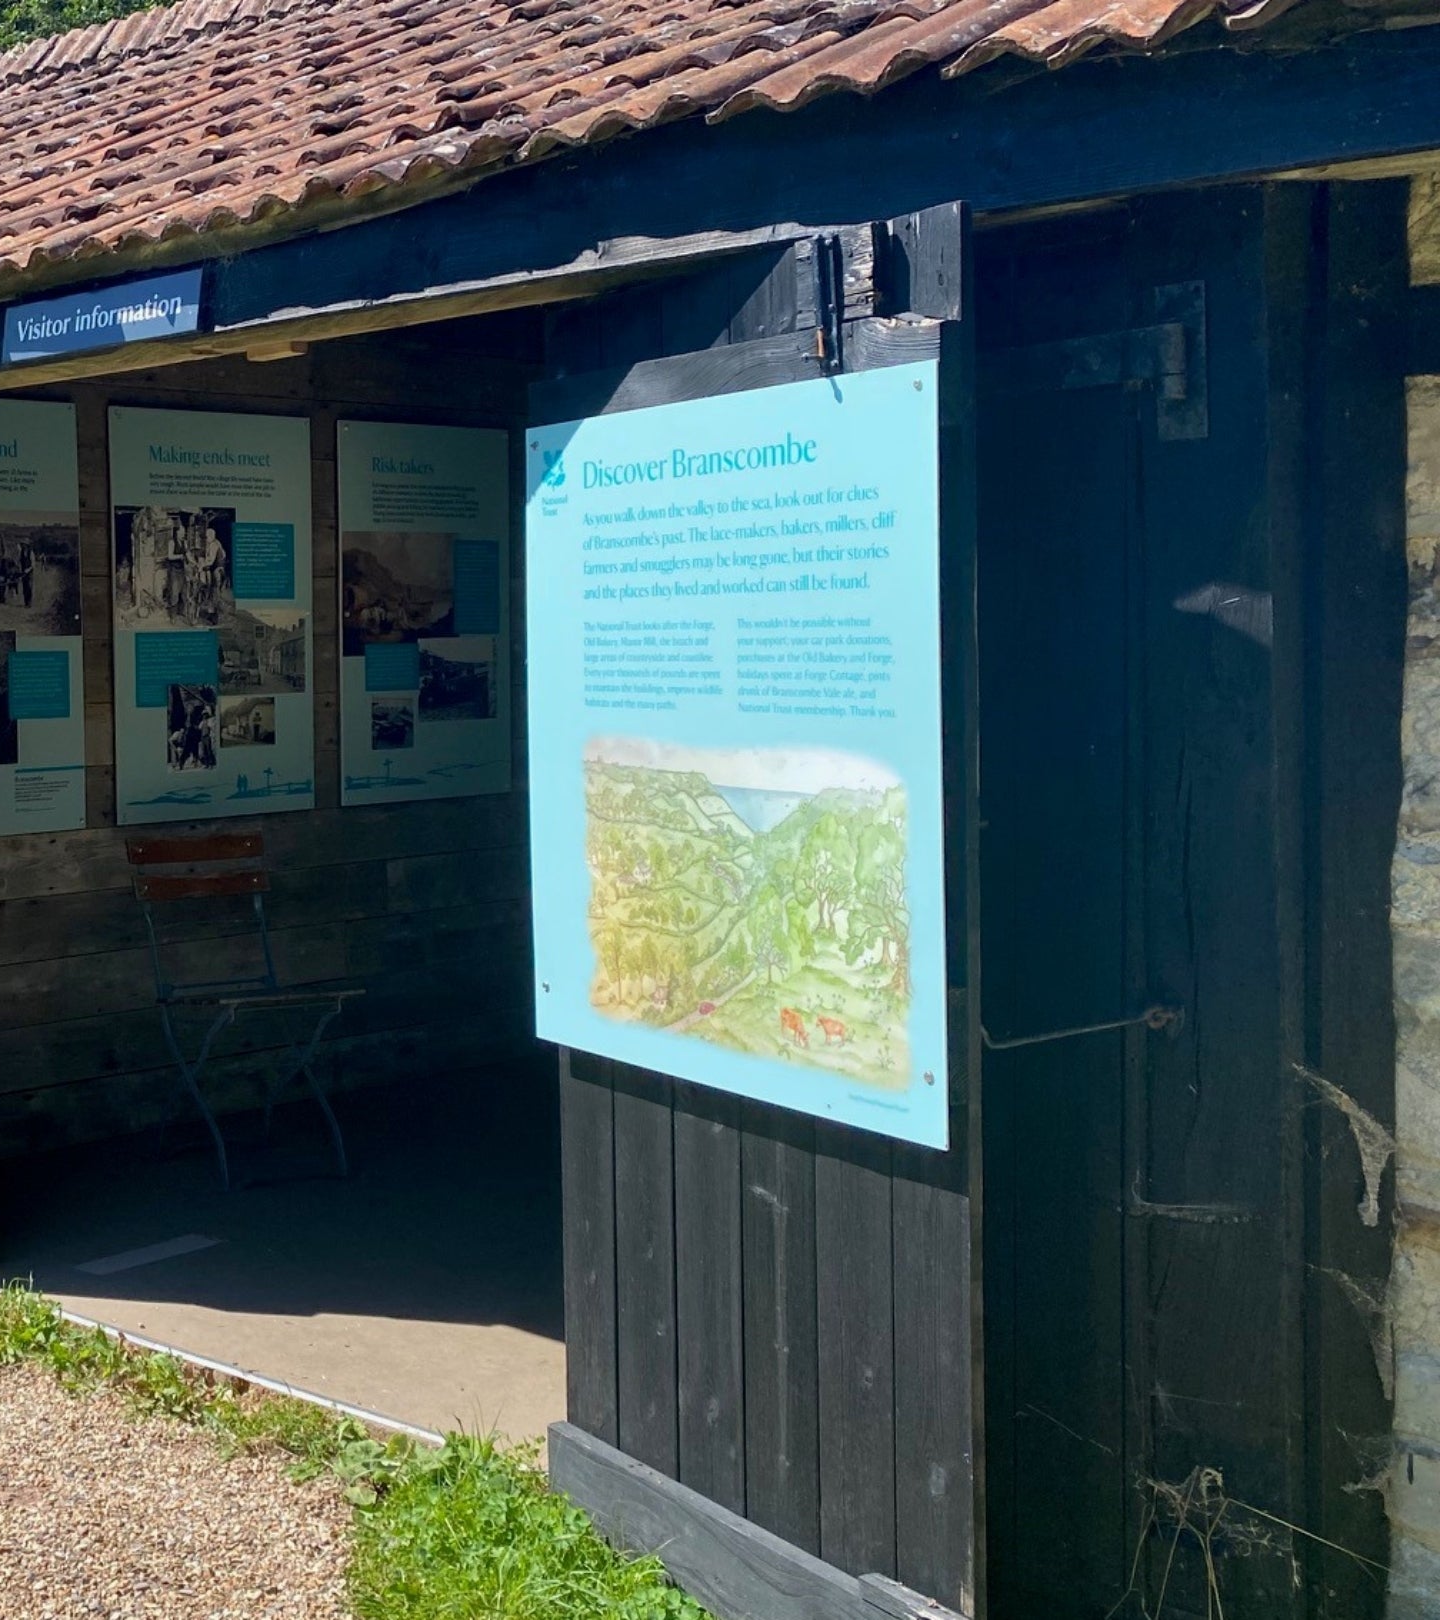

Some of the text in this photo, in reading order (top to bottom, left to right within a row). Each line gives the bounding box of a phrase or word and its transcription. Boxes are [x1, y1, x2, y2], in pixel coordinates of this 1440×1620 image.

[17, 294, 182, 342] Visitor information
[149, 445, 271, 469] Making ends meet
[583, 432, 817, 489] Discover Branscombe
[583, 512, 593, 526] As
[593, 514, 613, 528] you
[614, 507, 636, 522] walk
[638, 506, 666, 521] down
[668, 502, 685, 518] the
[686, 499, 714, 518] valley
[717, 502, 729, 514] to
[731, 496, 749, 512] the
[775, 490, 800, 508] look
[803, 491, 824, 505] out
[827, 488, 845, 503] for
[847, 485, 879, 502] clues
[582, 536, 592, 550] of
[688, 527, 709, 542] The
[871, 510, 898, 529] cliff
[583, 560, 618, 575] farmers
[620, 557, 638, 573] and
[640, 555, 690, 574] smugglers
[693, 557, 713, 572] may
[716, 551, 730, 567] be
[733, 550, 757, 569] long
[793, 547, 813, 563] but
[816, 544, 844, 561] their
[847, 542, 890, 559] stories
[583, 584, 600, 600] and
[602, 584, 617, 599] the
[619, 583, 649, 603] places
[652, 581, 671, 600] they
[675, 579, 698, 595] lived
[700, 578, 720, 595] and
[722, 577, 764, 594] worked
[766, 580, 787, 593] can
[789, 573, 809, 591] still
[812, 573, 828, 590] be
